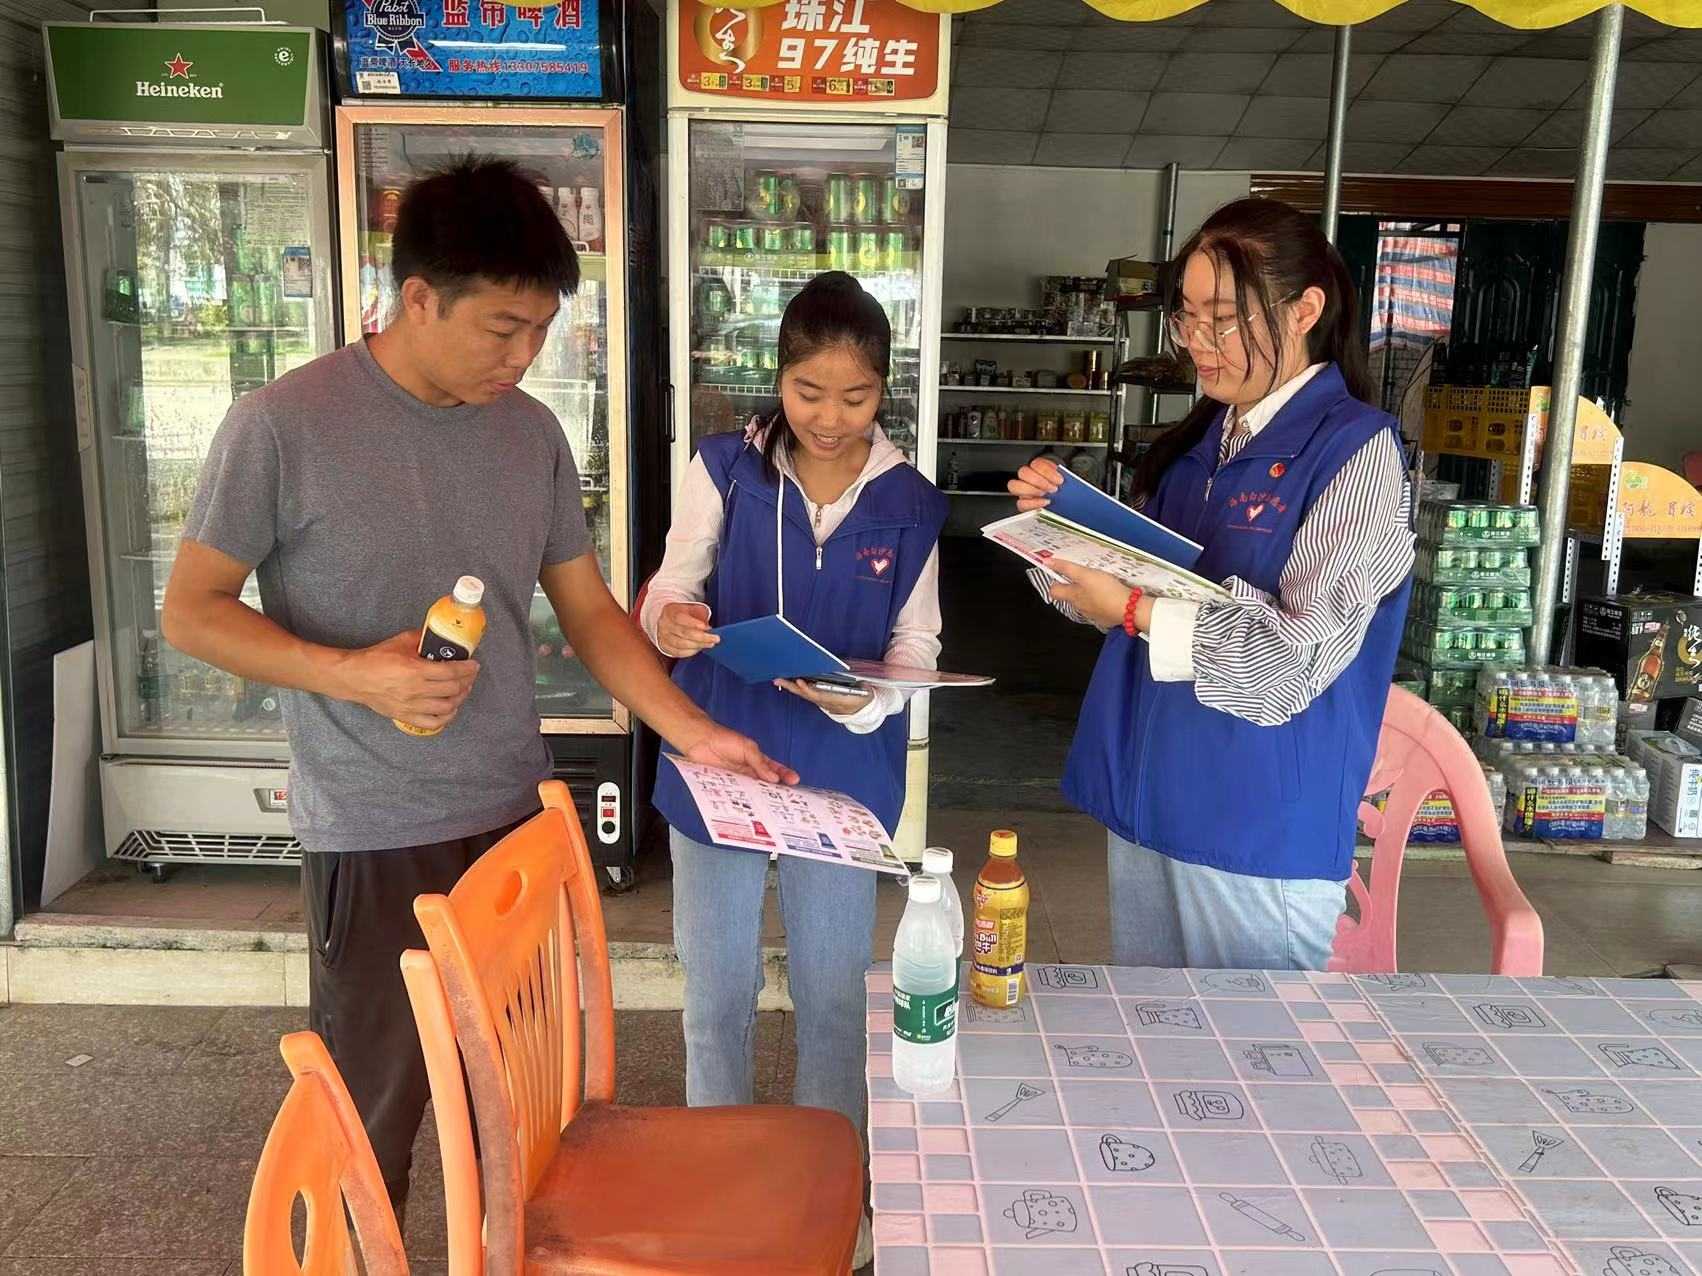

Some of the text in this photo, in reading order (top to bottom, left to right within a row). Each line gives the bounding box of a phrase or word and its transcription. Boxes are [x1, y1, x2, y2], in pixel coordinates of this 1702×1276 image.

[378, 0, 410, 13] Pabst
[367, 13, 422, 26] Blue Ribbon
[781, 0, 871, 33] 珠江
[776, 37, 918, 75] 97纯生
[135, 81, 223, 98] Heineken
